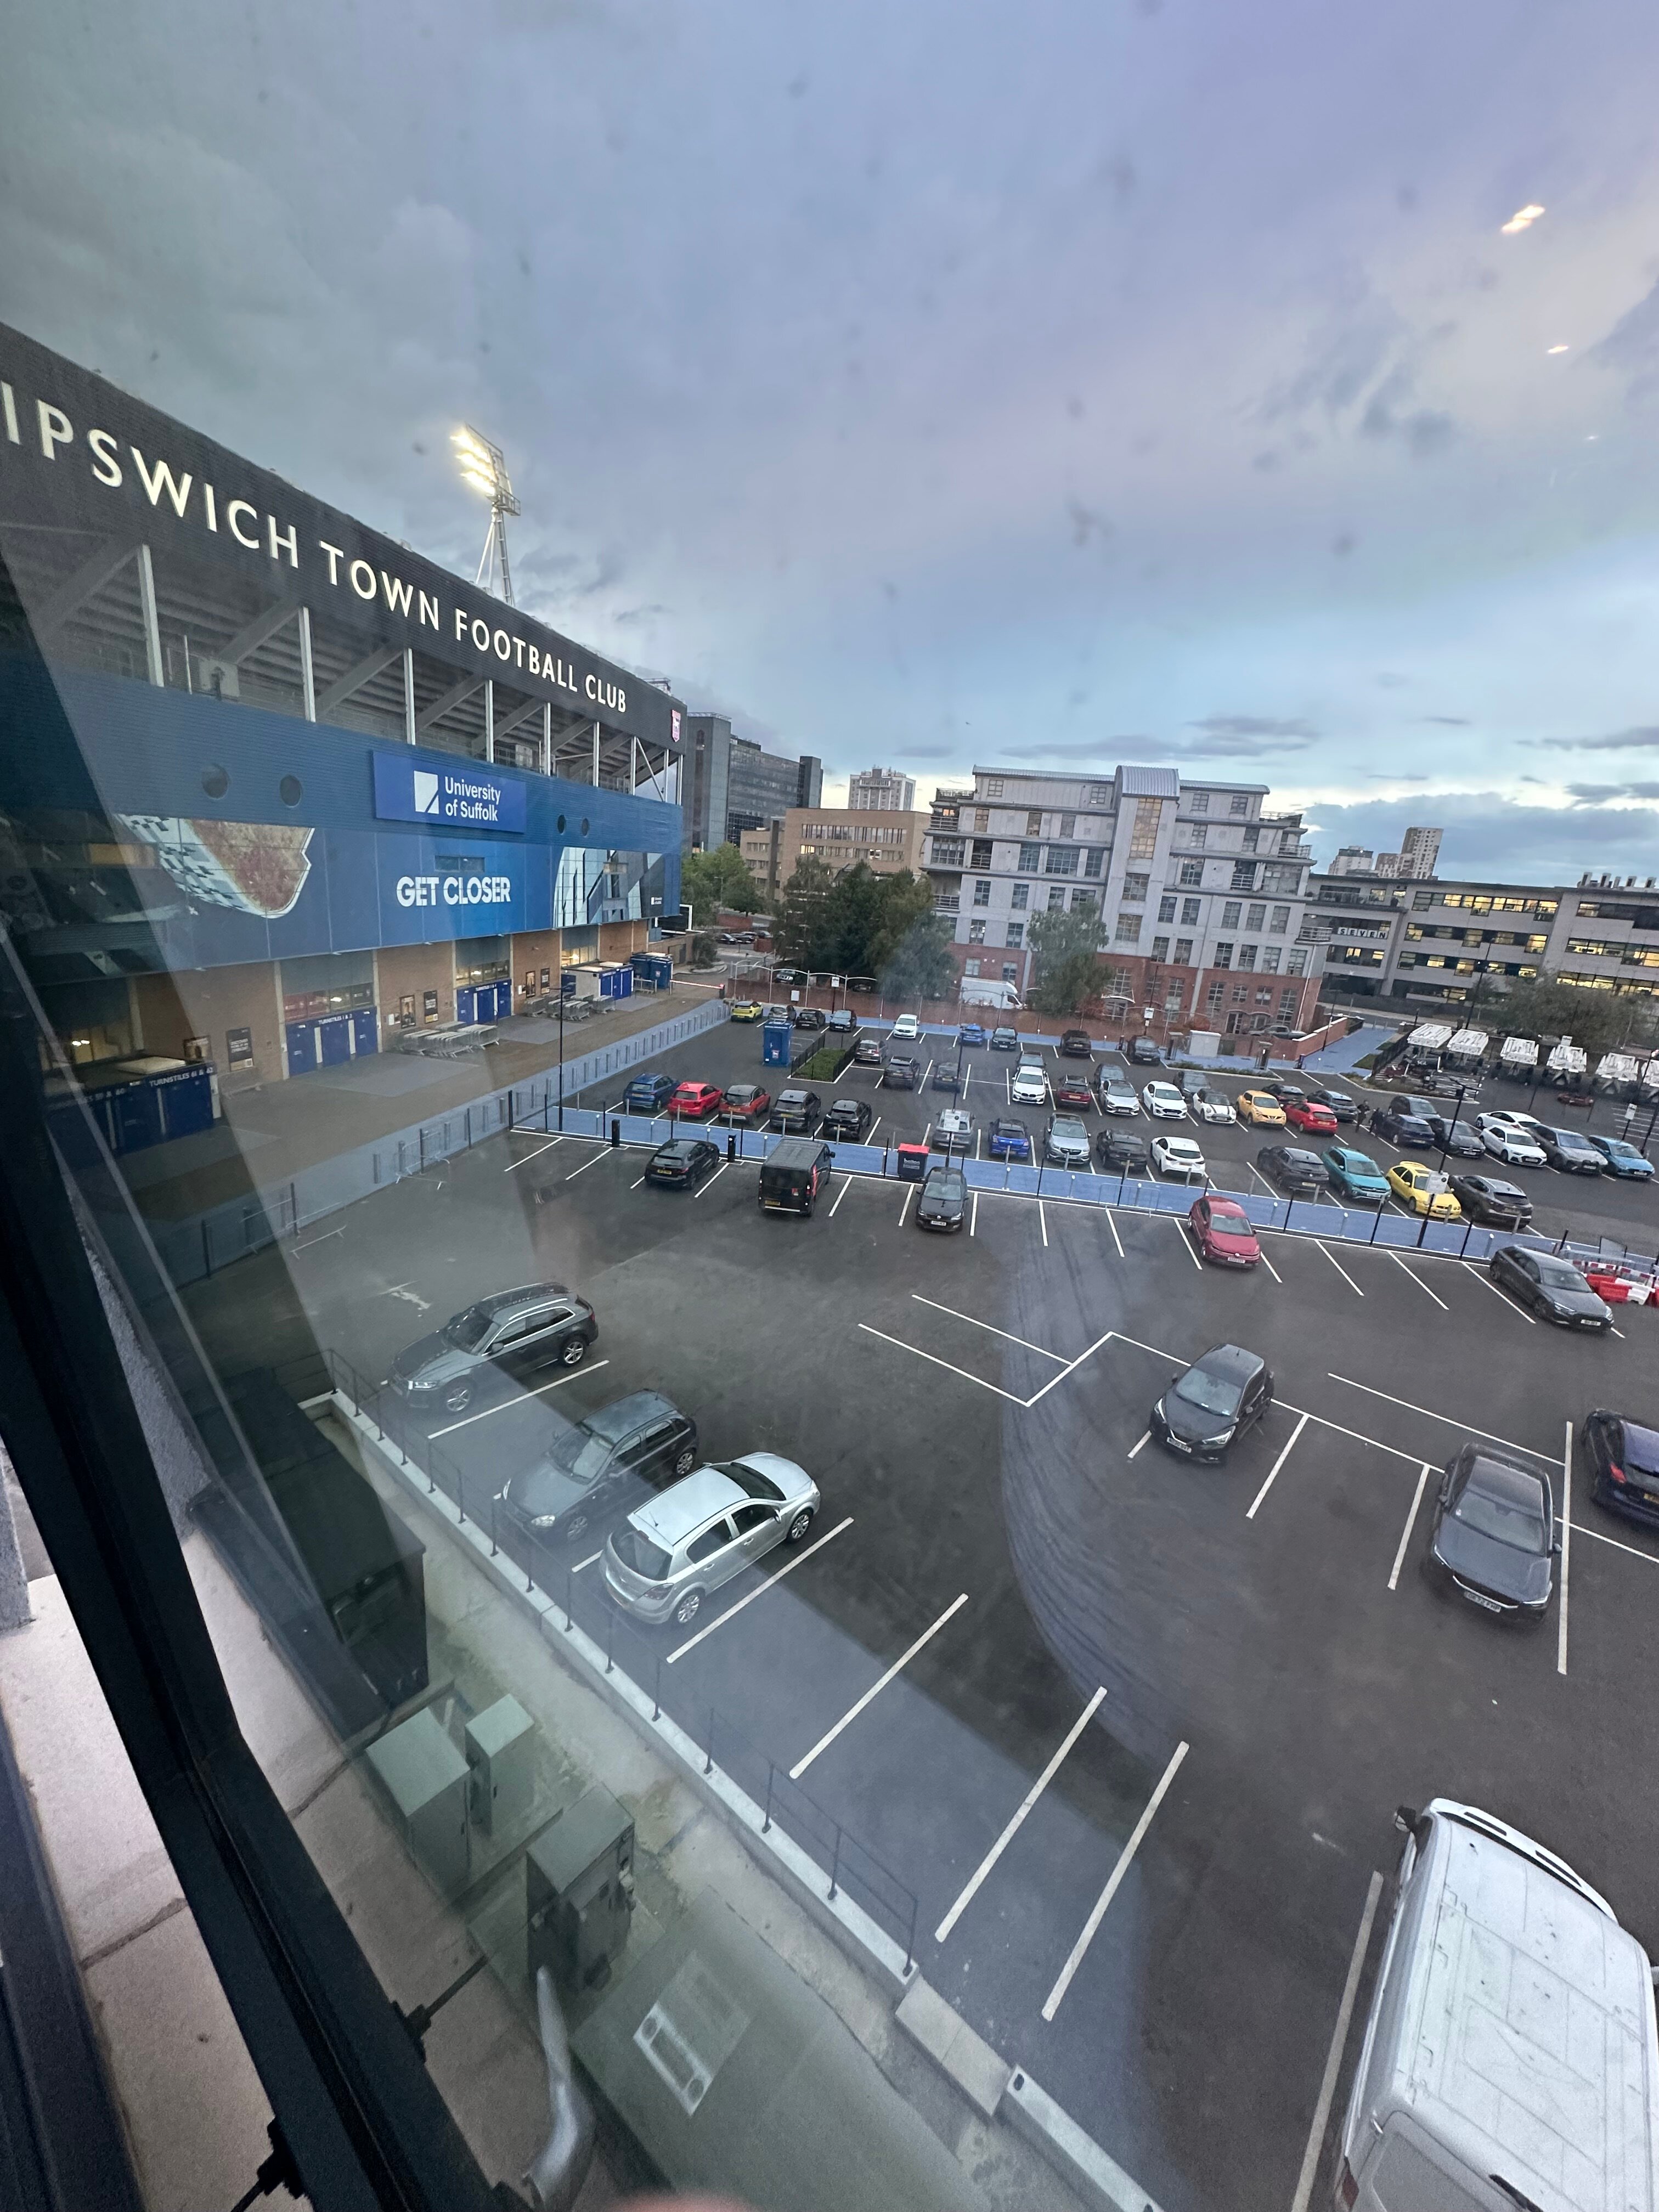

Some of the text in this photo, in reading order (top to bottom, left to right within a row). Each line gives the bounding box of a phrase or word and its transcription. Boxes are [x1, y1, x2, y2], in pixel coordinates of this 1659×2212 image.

[1, 381, 626, 712] IPSWICH TOWN FOOTBALL CLUB
[445, 776, 501, 805] University
[445, 799, 498, 821] of Suffolk
[397, 877, 511, 907] GET CLOSER
[1340, 928, 1386, 938] SEVEN
[149, 1072, 190, 1087] TURNSTILES
